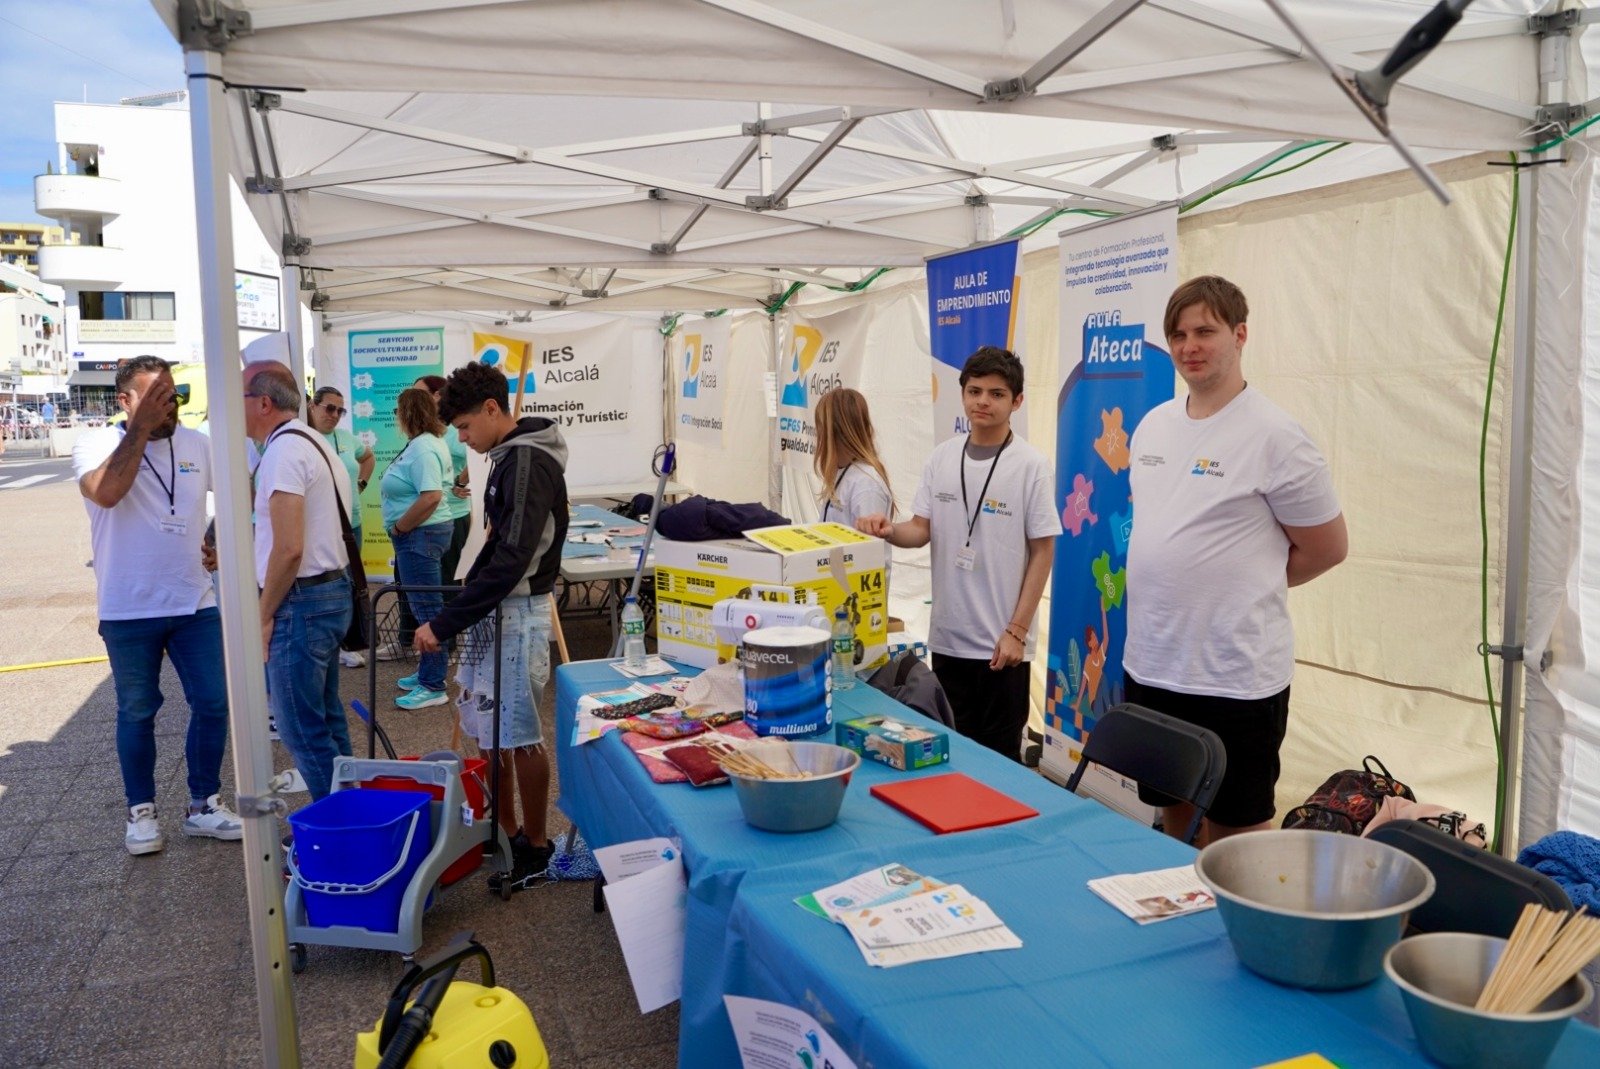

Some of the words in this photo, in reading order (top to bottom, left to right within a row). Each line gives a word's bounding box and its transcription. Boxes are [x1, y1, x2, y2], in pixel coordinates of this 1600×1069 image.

[1100, 240, 1131, 255] Formación
[1065, 260, 1095, 276] integrando
[1095, 254, 1125, 270] tecnología
[1125, 250, 1156, 263] avanzada
[1157, 247, 1169, 260] que
[953, 272, 976, 290] AULA
[977, 271, 988, 286] DE
[1066, 277, 1087, 289] impulsa
[1094, 269, 1127, 284] creatividad,
[1128, 262, 1163, 277] innovación
[1094, 280, 1134, 296] colaboración.
[936, 288, 1011, 313] EMPRENDIMIENTO
[1086, 309, 1121, 329] AULA
[377, 336, 415, 344] SERVICIOS
[1086, 334, 1143, 364] Ateca
[353, 346, 418, 354] SOCIOCULTURALES
[376, 355, 418, 363] COMUNIDAD
[542, 346, 575, 364] IES
[702, 344, 713, 362] IES
[818, 340, 840, 363] IES
[544, 363, 600, 384] Alcalá
[700, 370, 717, 388] Alcalá
[566, 415, 574, 427] y
[780, 417, 800, 433] CFGS
[1205, 469, 1226, 478] Alcalá
[697, 552, 728, 564] KÄRCHER
[860, 573, 871, 593] K
[872, 571, 882, 589] 4
[769, 722, 817, 734] multiusos
